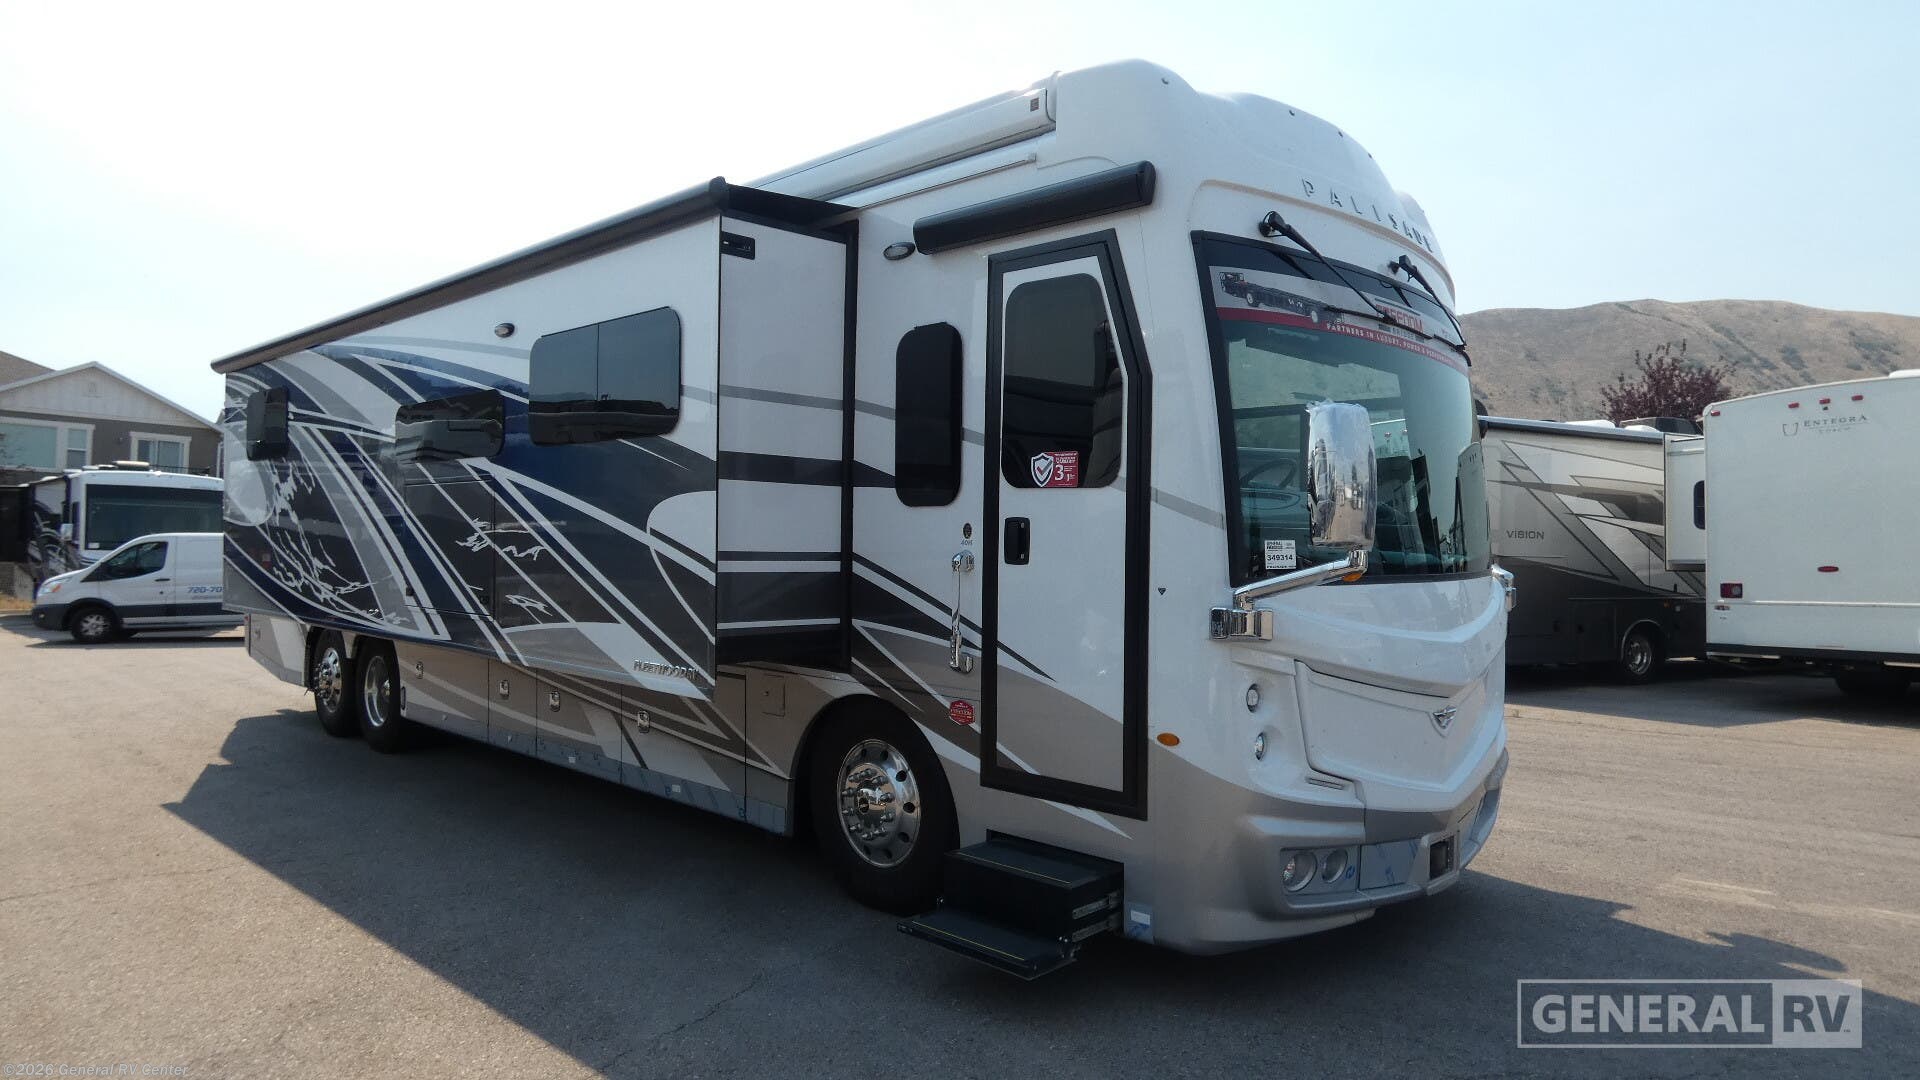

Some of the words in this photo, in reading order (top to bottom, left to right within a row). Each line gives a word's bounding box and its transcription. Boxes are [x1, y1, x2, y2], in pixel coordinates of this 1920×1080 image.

[1326, 322, 1364, 336] PARTNERS
[1366, 331, 1374, 339] IN
[1506, 529, 1545, 540] VISION
